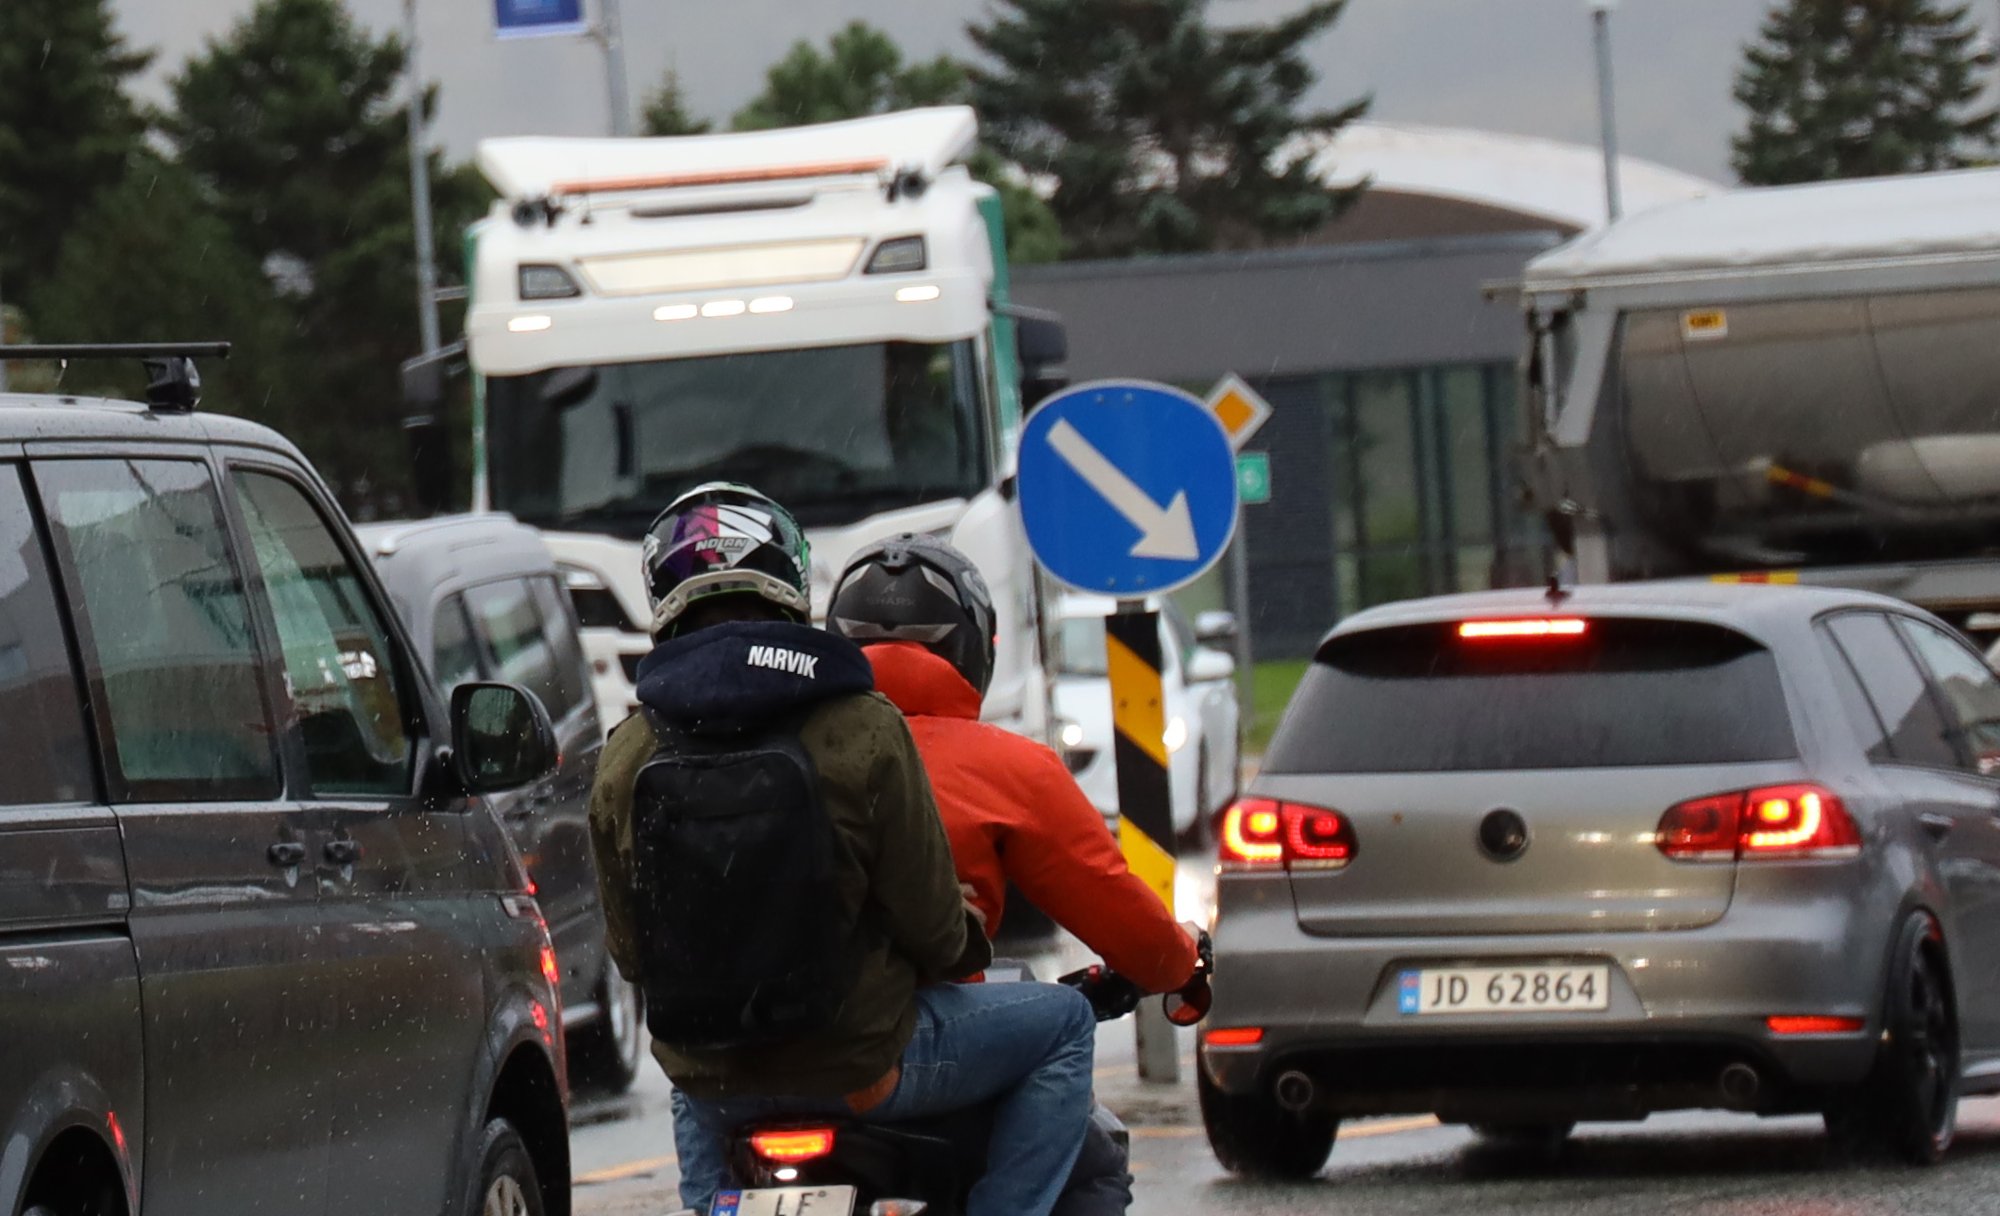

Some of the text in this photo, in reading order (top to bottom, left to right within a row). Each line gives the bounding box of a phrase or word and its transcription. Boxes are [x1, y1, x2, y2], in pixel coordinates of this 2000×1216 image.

[695, 537, 749, 553] NOLAN
[747, 645, 819, 680] NARVIK
[1431, 973, 1596, 1007] JD 62864
